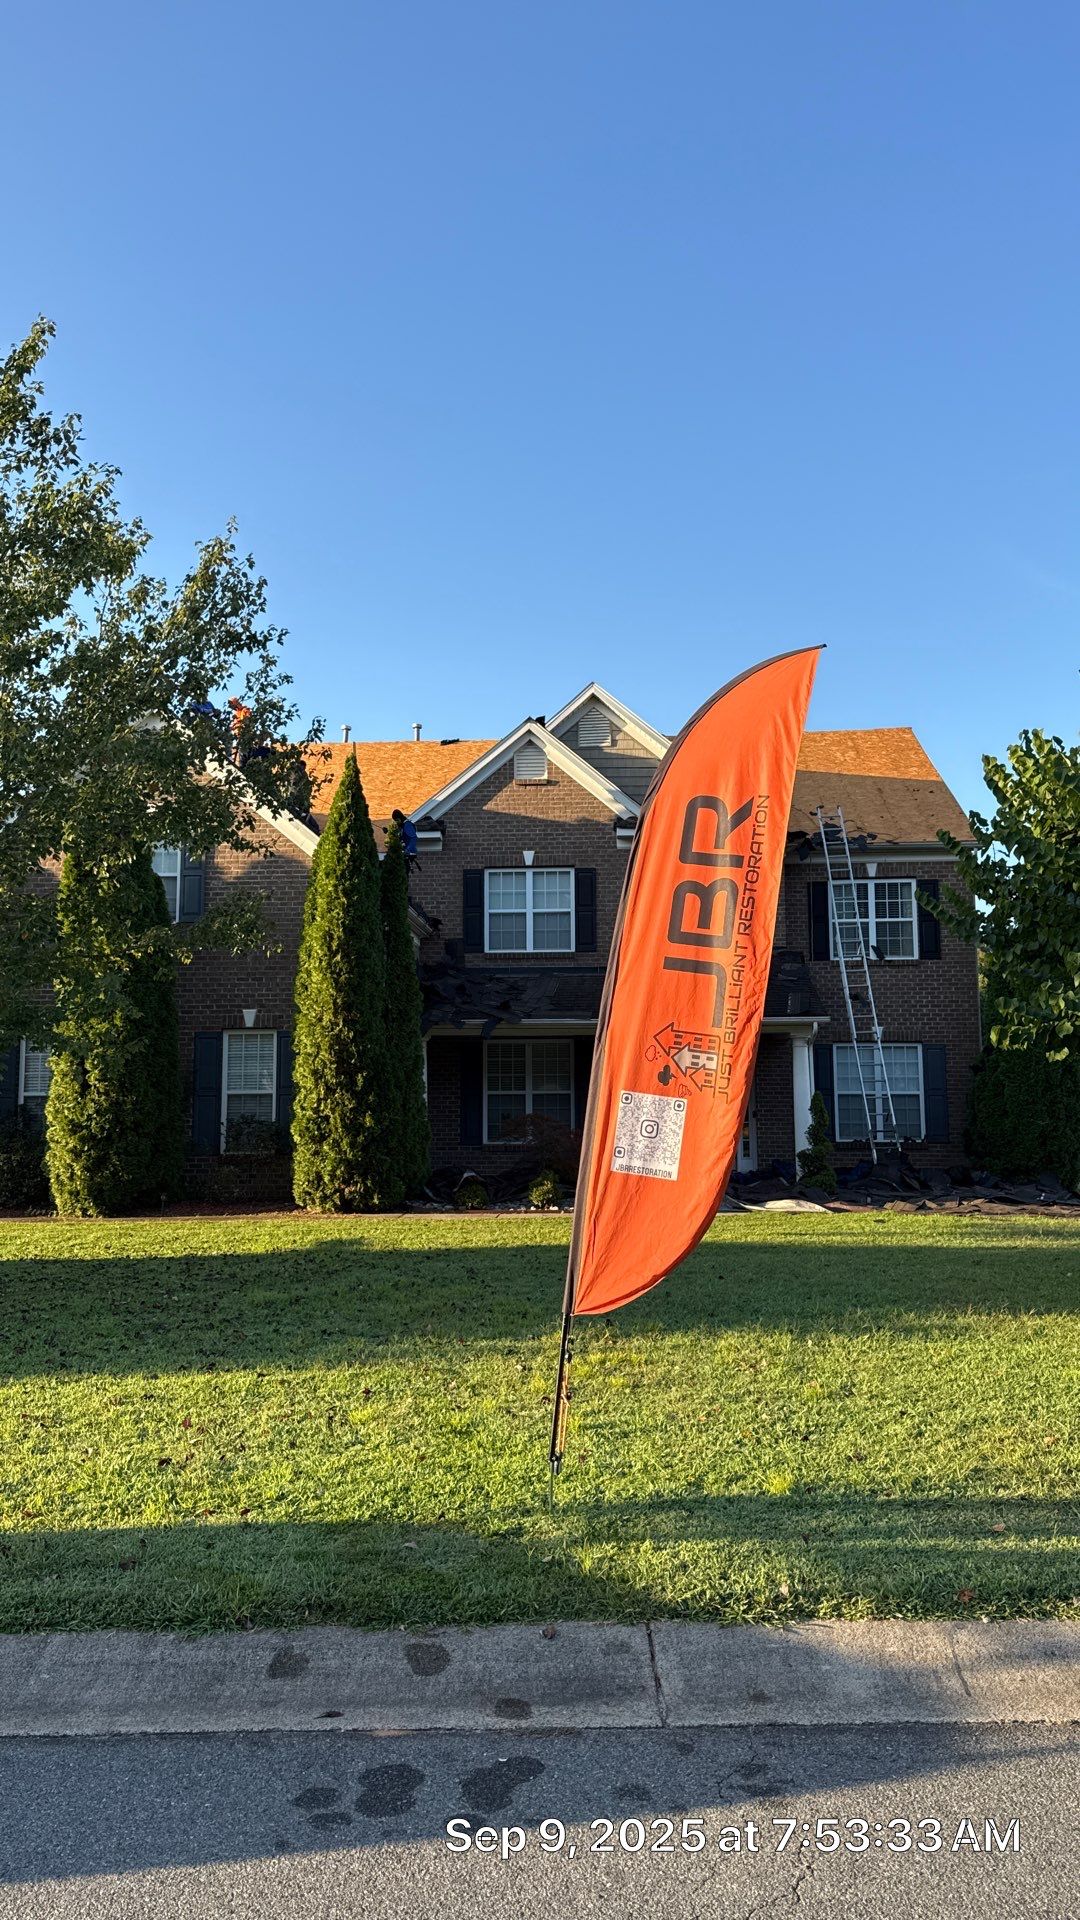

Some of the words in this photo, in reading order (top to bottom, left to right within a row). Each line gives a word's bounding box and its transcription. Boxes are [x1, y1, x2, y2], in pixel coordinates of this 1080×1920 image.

[663, 795, 755, 1028] JBR
[718, 1048, 734, 1105] JUST
[615, 1163, 673, 1179] JBRRESTORATION
